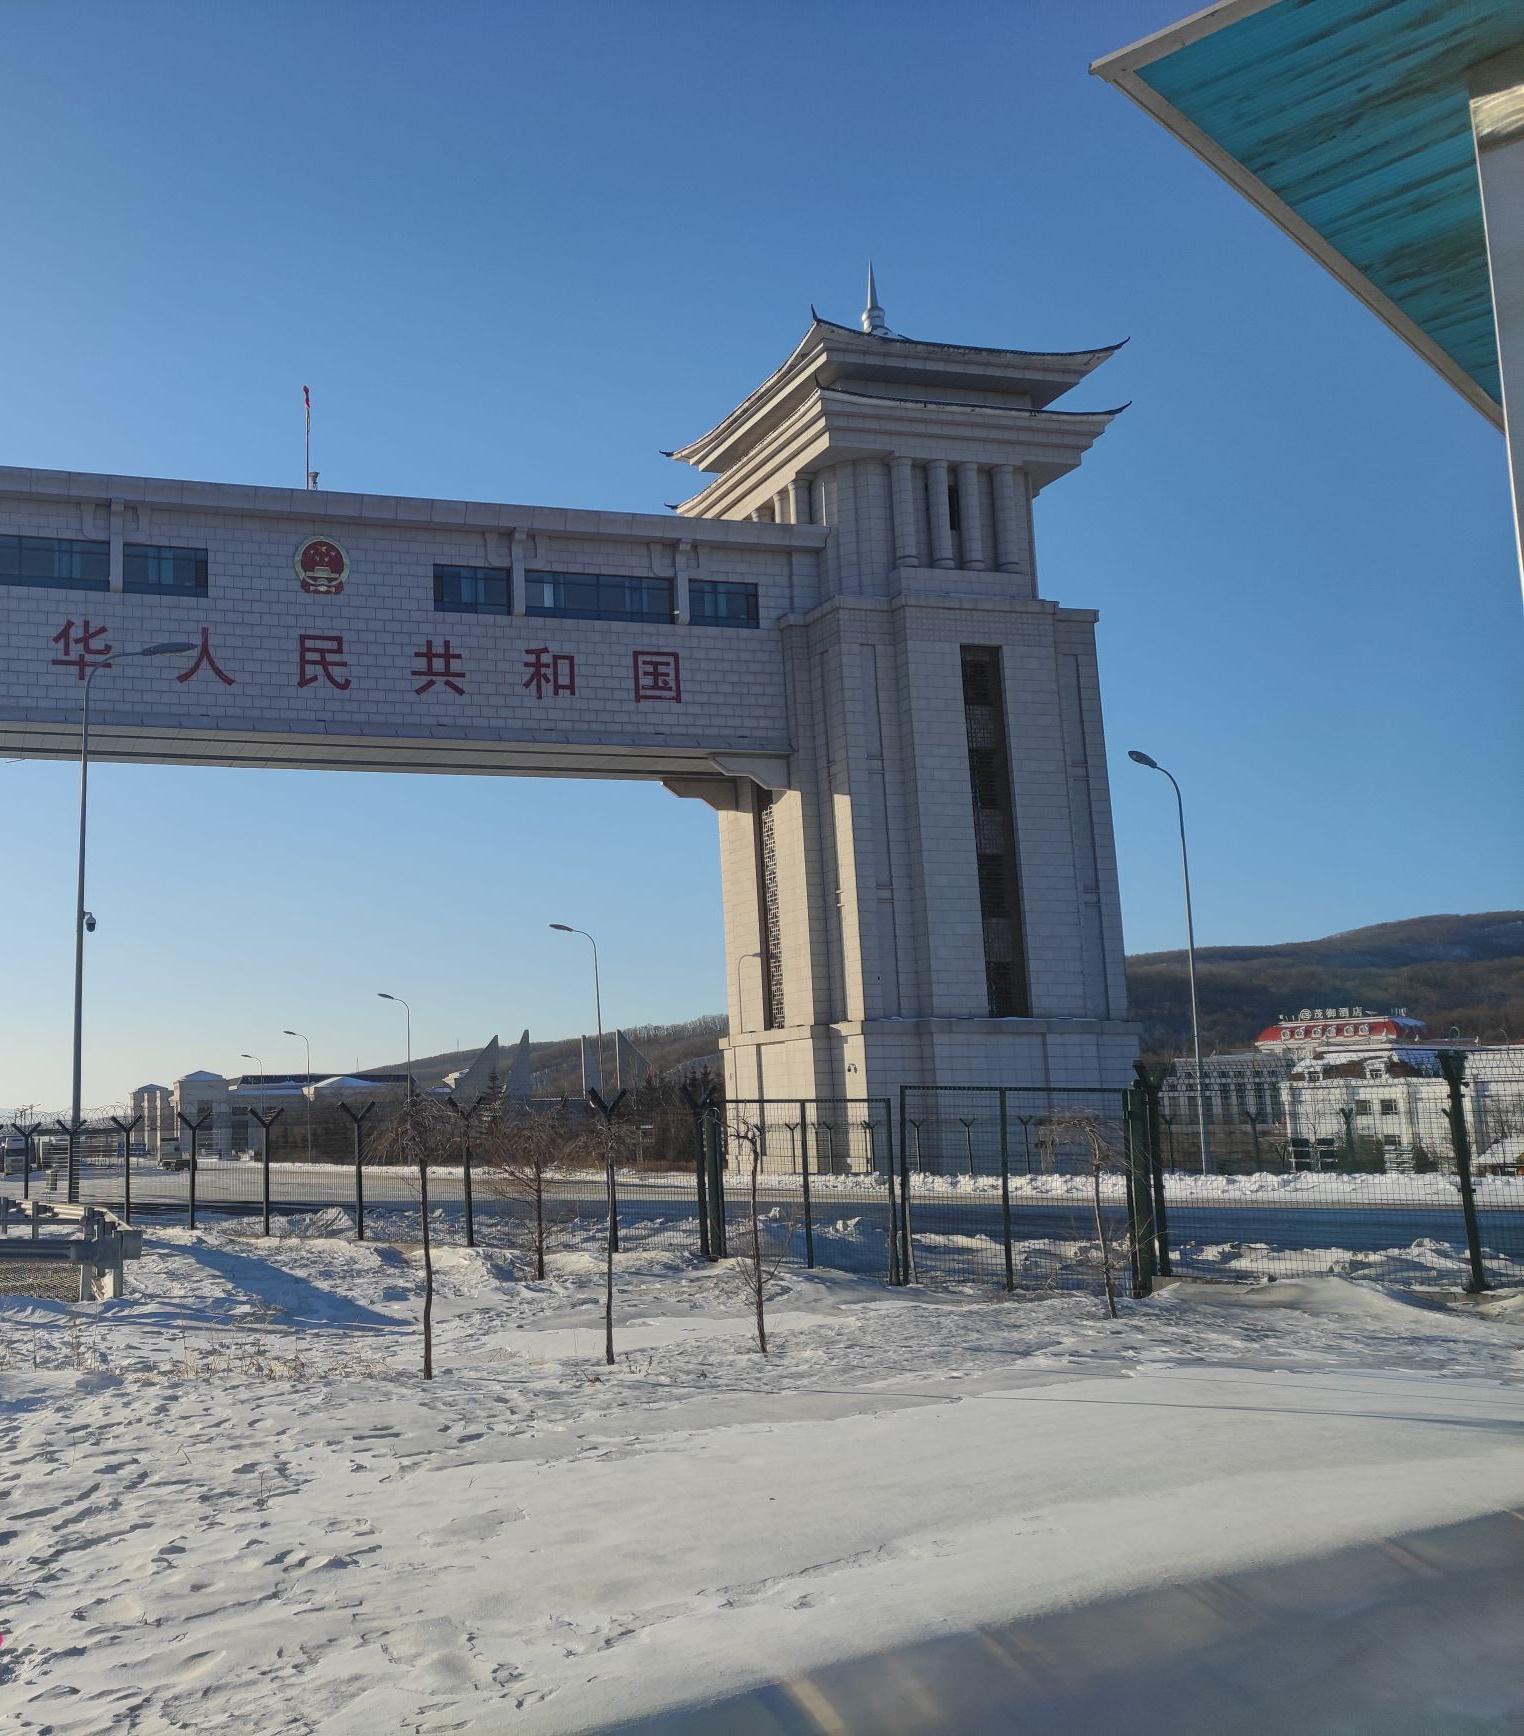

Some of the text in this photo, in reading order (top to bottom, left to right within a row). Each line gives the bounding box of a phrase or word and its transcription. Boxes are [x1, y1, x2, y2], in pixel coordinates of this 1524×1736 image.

[51, 619, 683, 703] 华人民共和国
